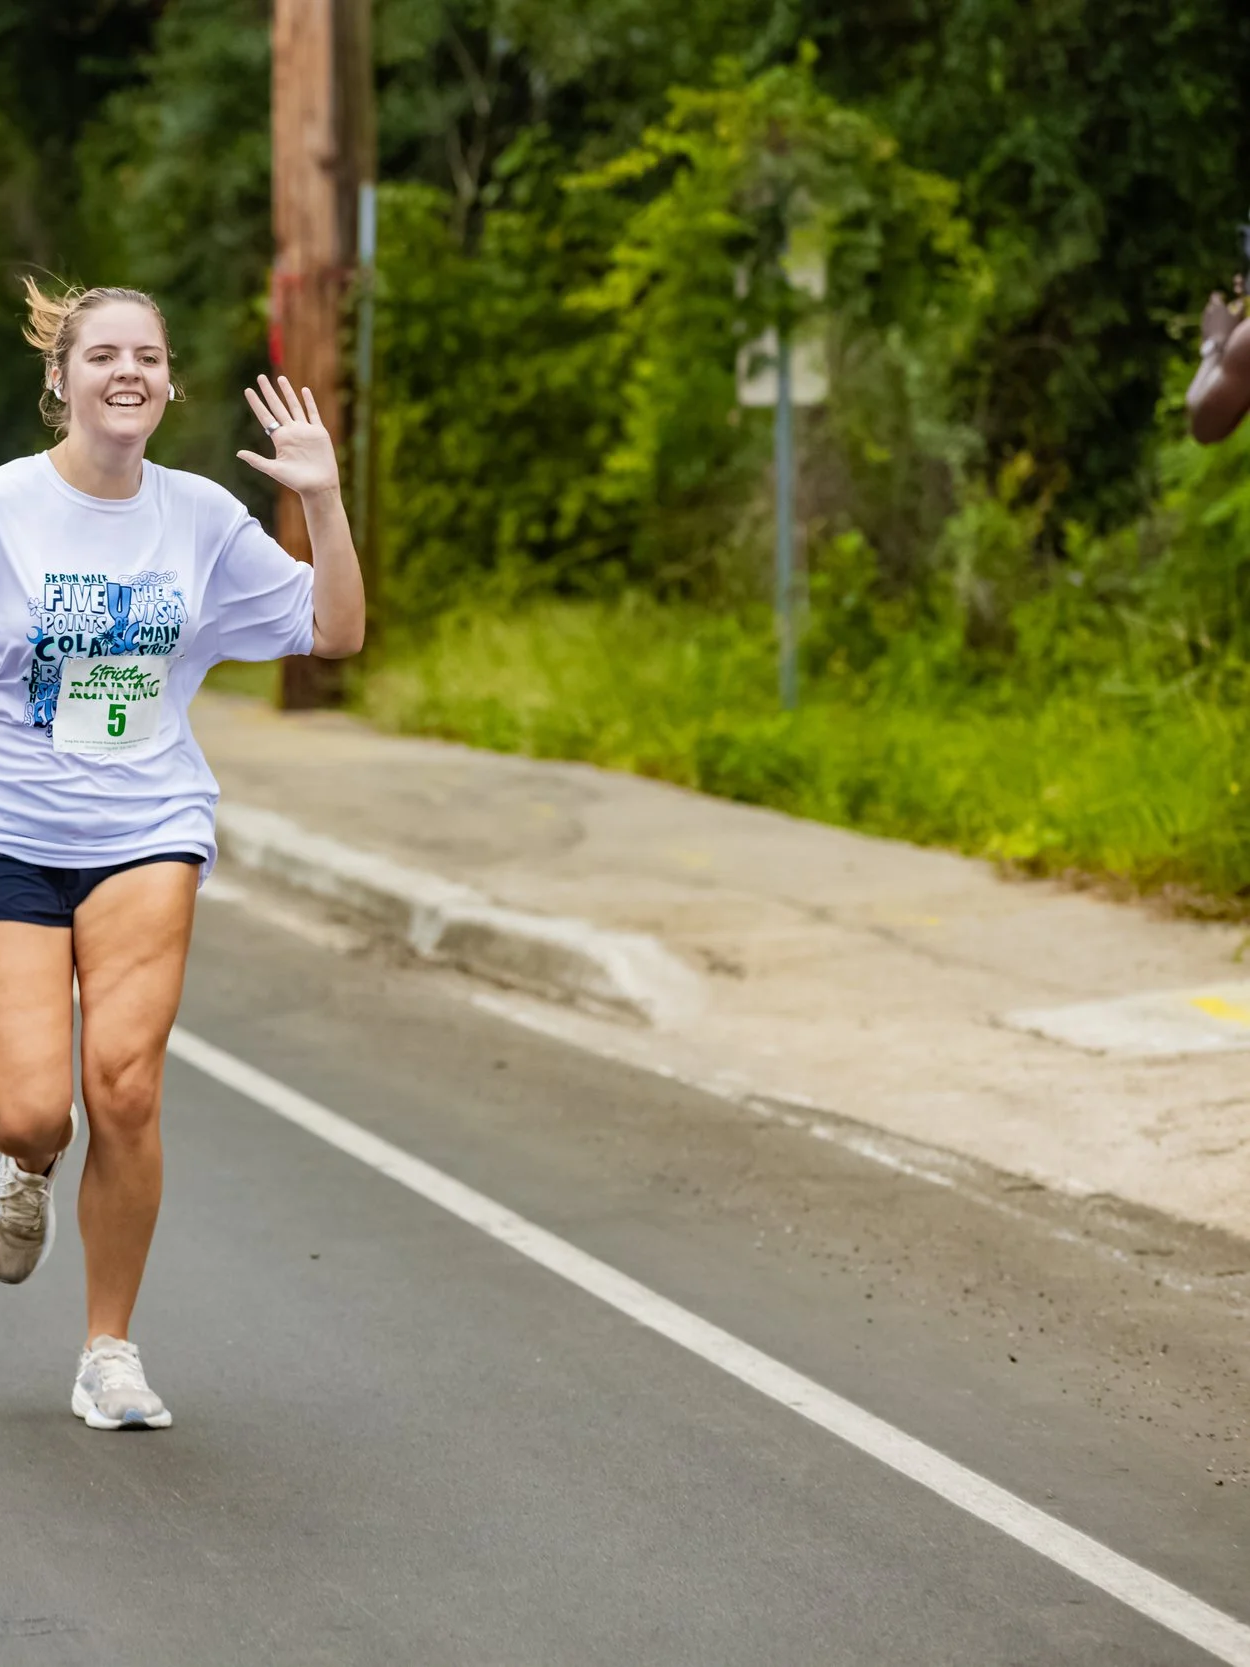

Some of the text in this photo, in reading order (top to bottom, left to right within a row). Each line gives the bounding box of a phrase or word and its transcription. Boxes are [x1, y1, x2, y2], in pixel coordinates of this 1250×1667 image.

[45, 573, 108, 583] 5K RUN WALK
[44, 583, 106, 614] FIVE
[132, 584, 164, 602] THE
[41, 612, 107, 635] POINTS
[130, 601, 184, 625] VISTA
[140, 624, 180, 644] MAIN
[35, 633, 102, 662] COLA
[139, 644, 176, 656] STREET
[89, 664, 151, 684] Strictly
[69, 680, 160, 701] RUNNING
[107, 703, 127, 737] 5
